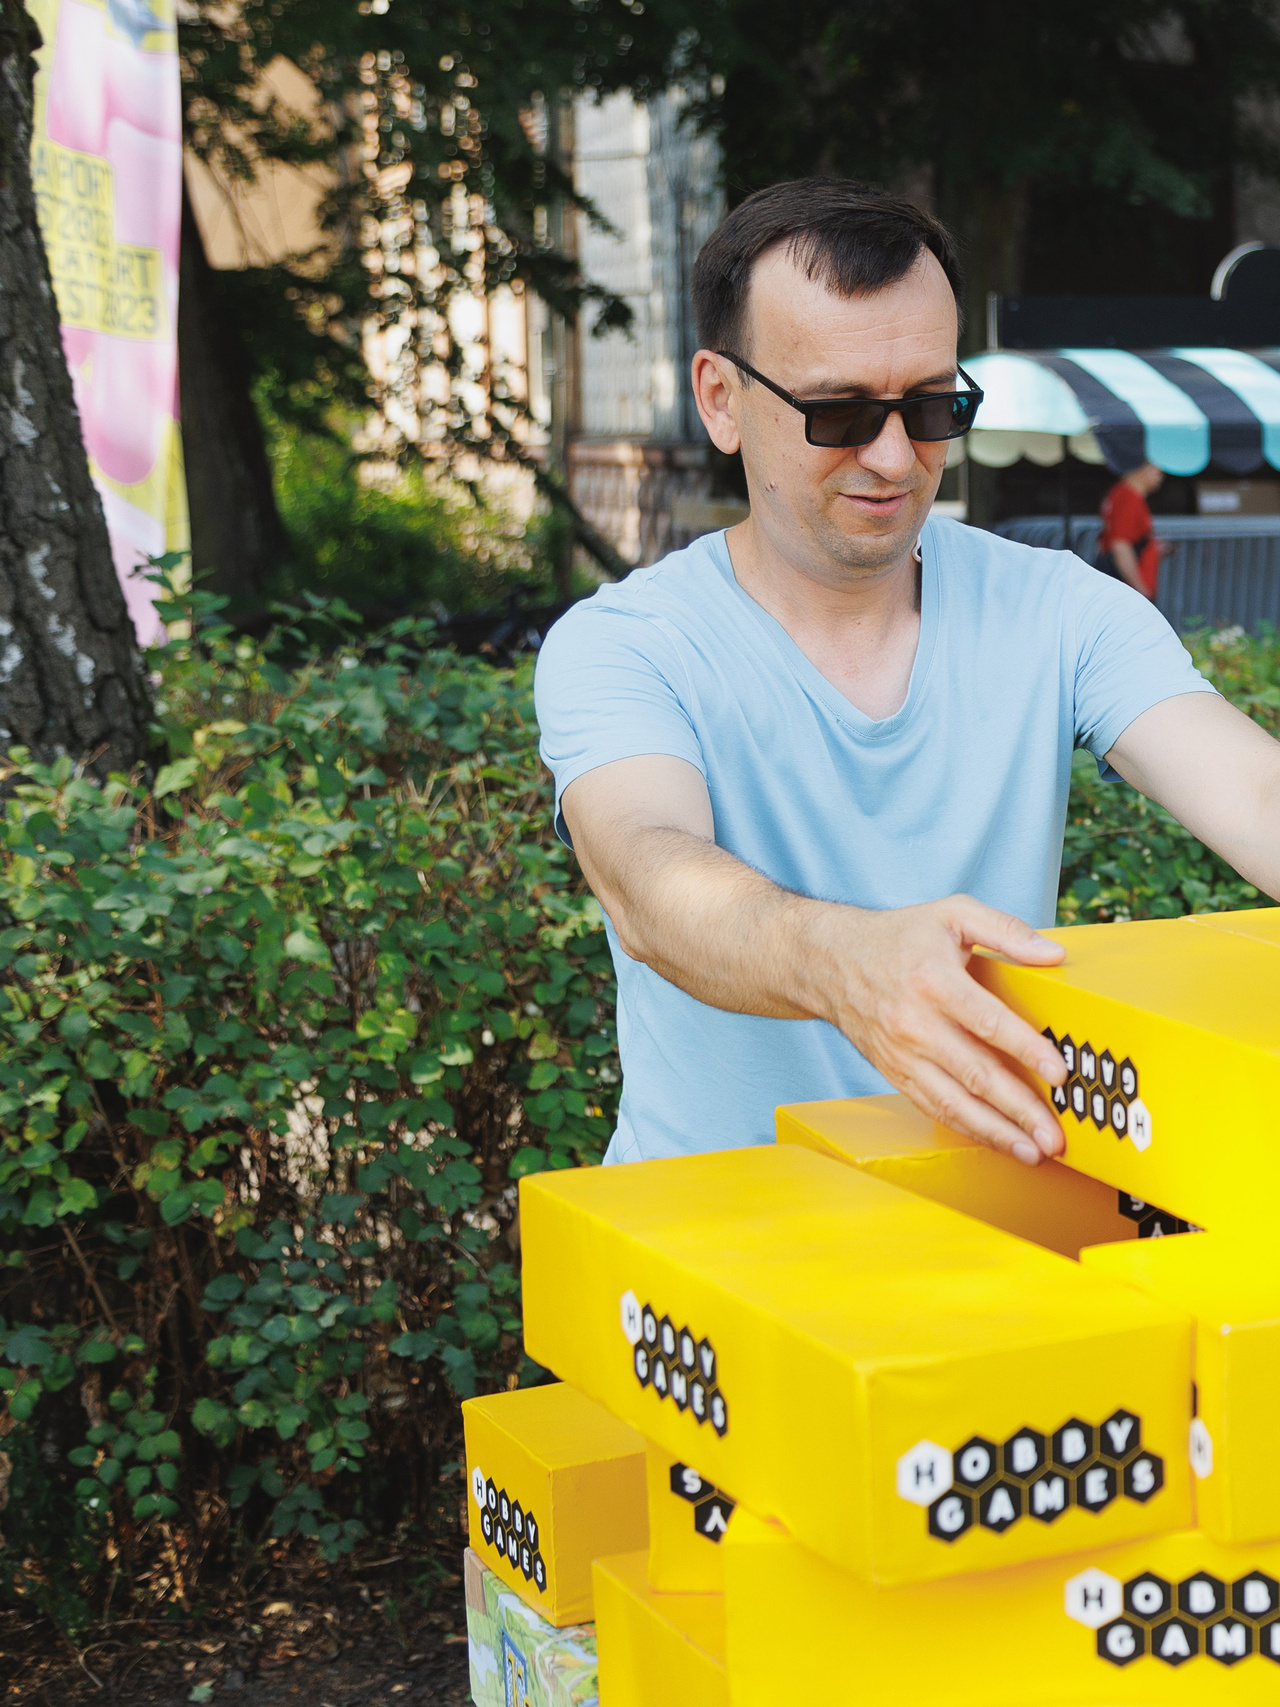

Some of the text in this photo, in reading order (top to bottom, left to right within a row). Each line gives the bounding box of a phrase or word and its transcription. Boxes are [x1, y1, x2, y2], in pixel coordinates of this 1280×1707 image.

[1049, 1038, 1137, 1096] GAME
[1052, 1084, 1146, 1139] HOBBY
[624, 1304, 716, 1380] HOBBY
[634, 1346, 728, 1430] GAMES
[914, 1415, 1137, 1488] HOBBY
[474, 1476, 537, 1545] HOBBY
[934, 1457, 1157, 1535] GAMES
[481, 1513, 545, 1587] GAMES
